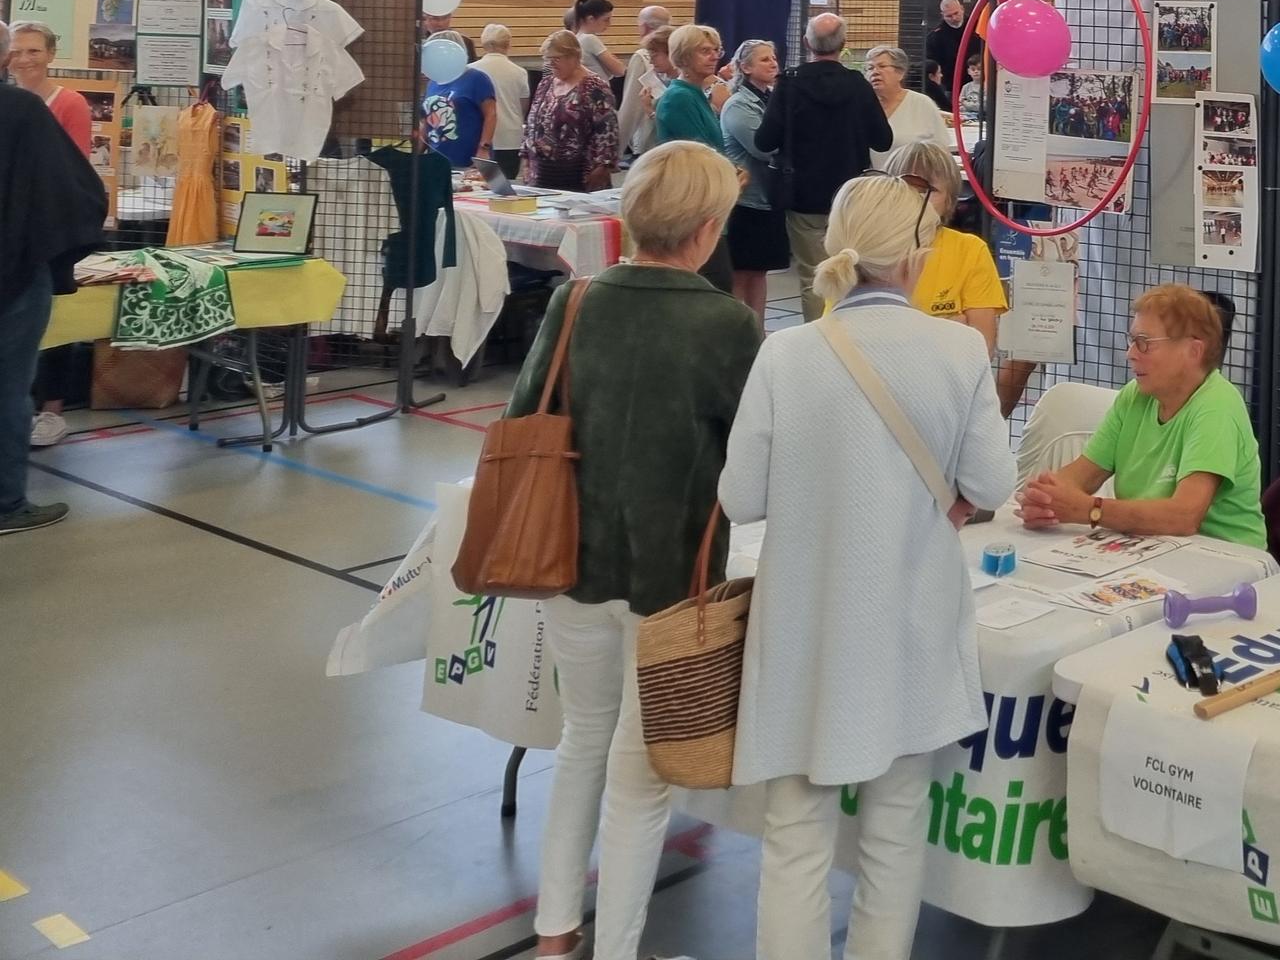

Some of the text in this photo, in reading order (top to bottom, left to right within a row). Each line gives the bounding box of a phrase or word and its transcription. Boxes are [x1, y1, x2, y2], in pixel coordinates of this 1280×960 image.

[525, 621, 545, 712] Fédération
[1145, 756, 1194, 782] FCL GYM
[1133, 775, 1202, 810] VOLONTAIRE
